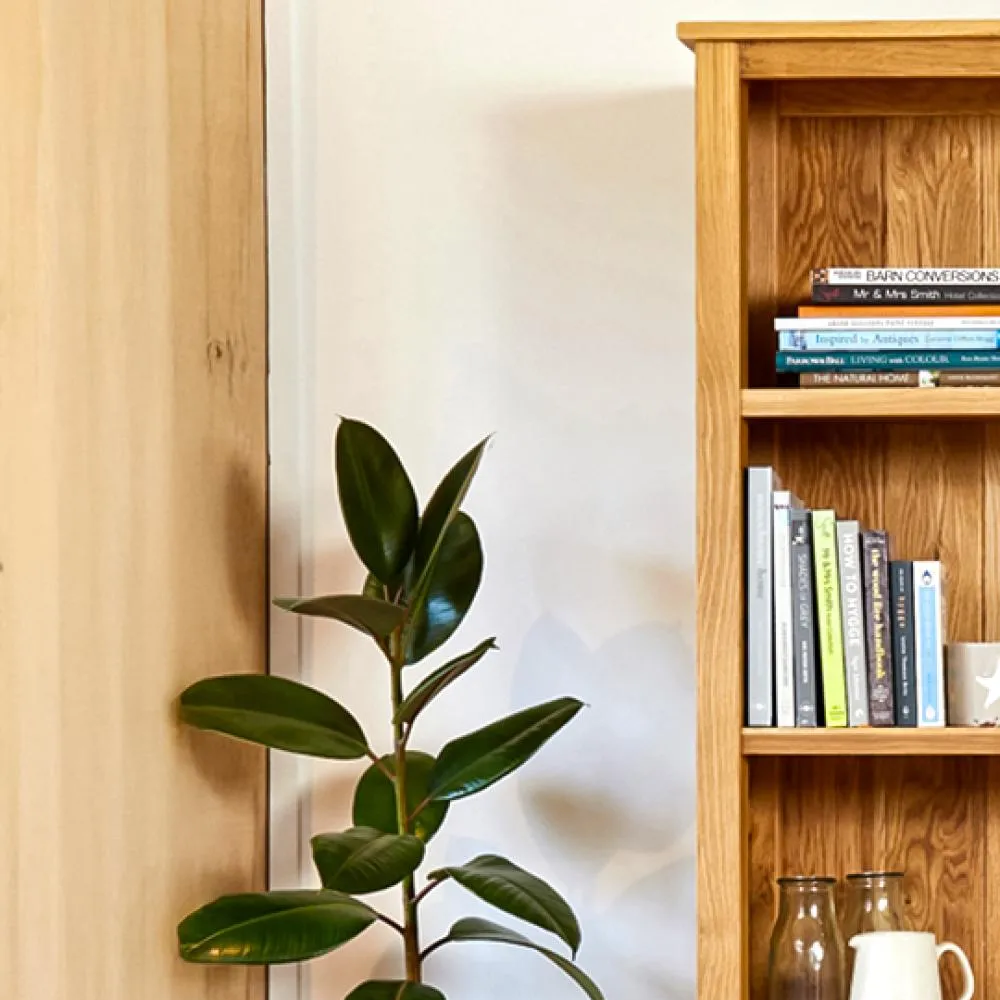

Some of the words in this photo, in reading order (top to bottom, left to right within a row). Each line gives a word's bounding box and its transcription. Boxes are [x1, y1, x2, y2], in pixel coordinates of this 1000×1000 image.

[866, 270, 903, 282] BARN
[905, 270, 1000, 282] CONVERSIONS
[910, 287, 941, 299] Smith
[815, 333, 859, 346] Inspired
[849, 354, 887, 365] LIVING
[843, 532, 857, 569] HOW
[845, 574, 859, 594] TO
